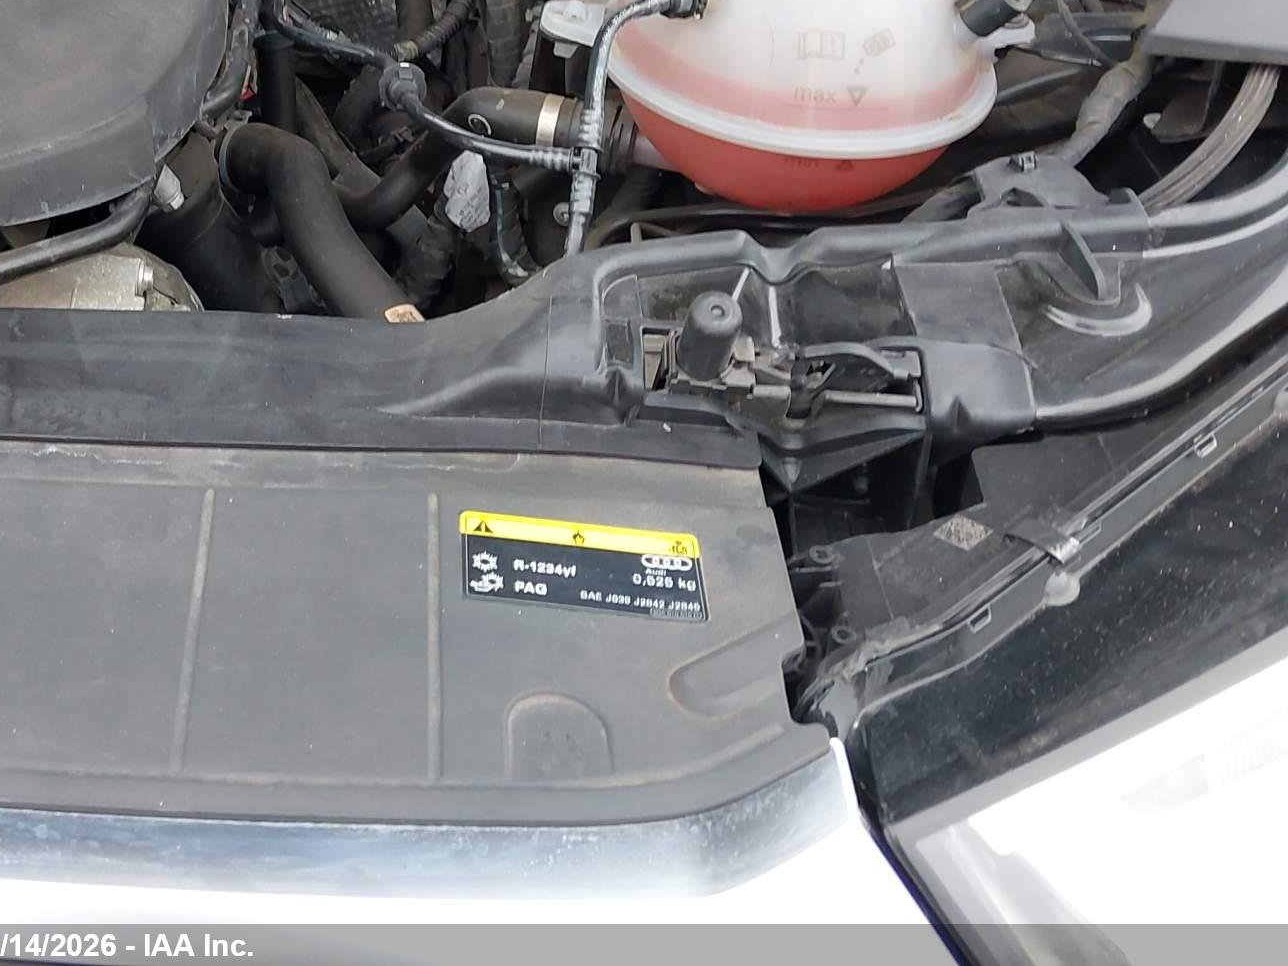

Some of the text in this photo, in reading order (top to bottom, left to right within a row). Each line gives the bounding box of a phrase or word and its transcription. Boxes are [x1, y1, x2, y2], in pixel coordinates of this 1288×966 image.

[512, 558, 577, 579] R-1234yf
[644, 568, 667, 576] Audi
[513, 580, 548, 596] PAG
[678, 577, 697, 592] kg
[579, 590, 603, 603] SAE
